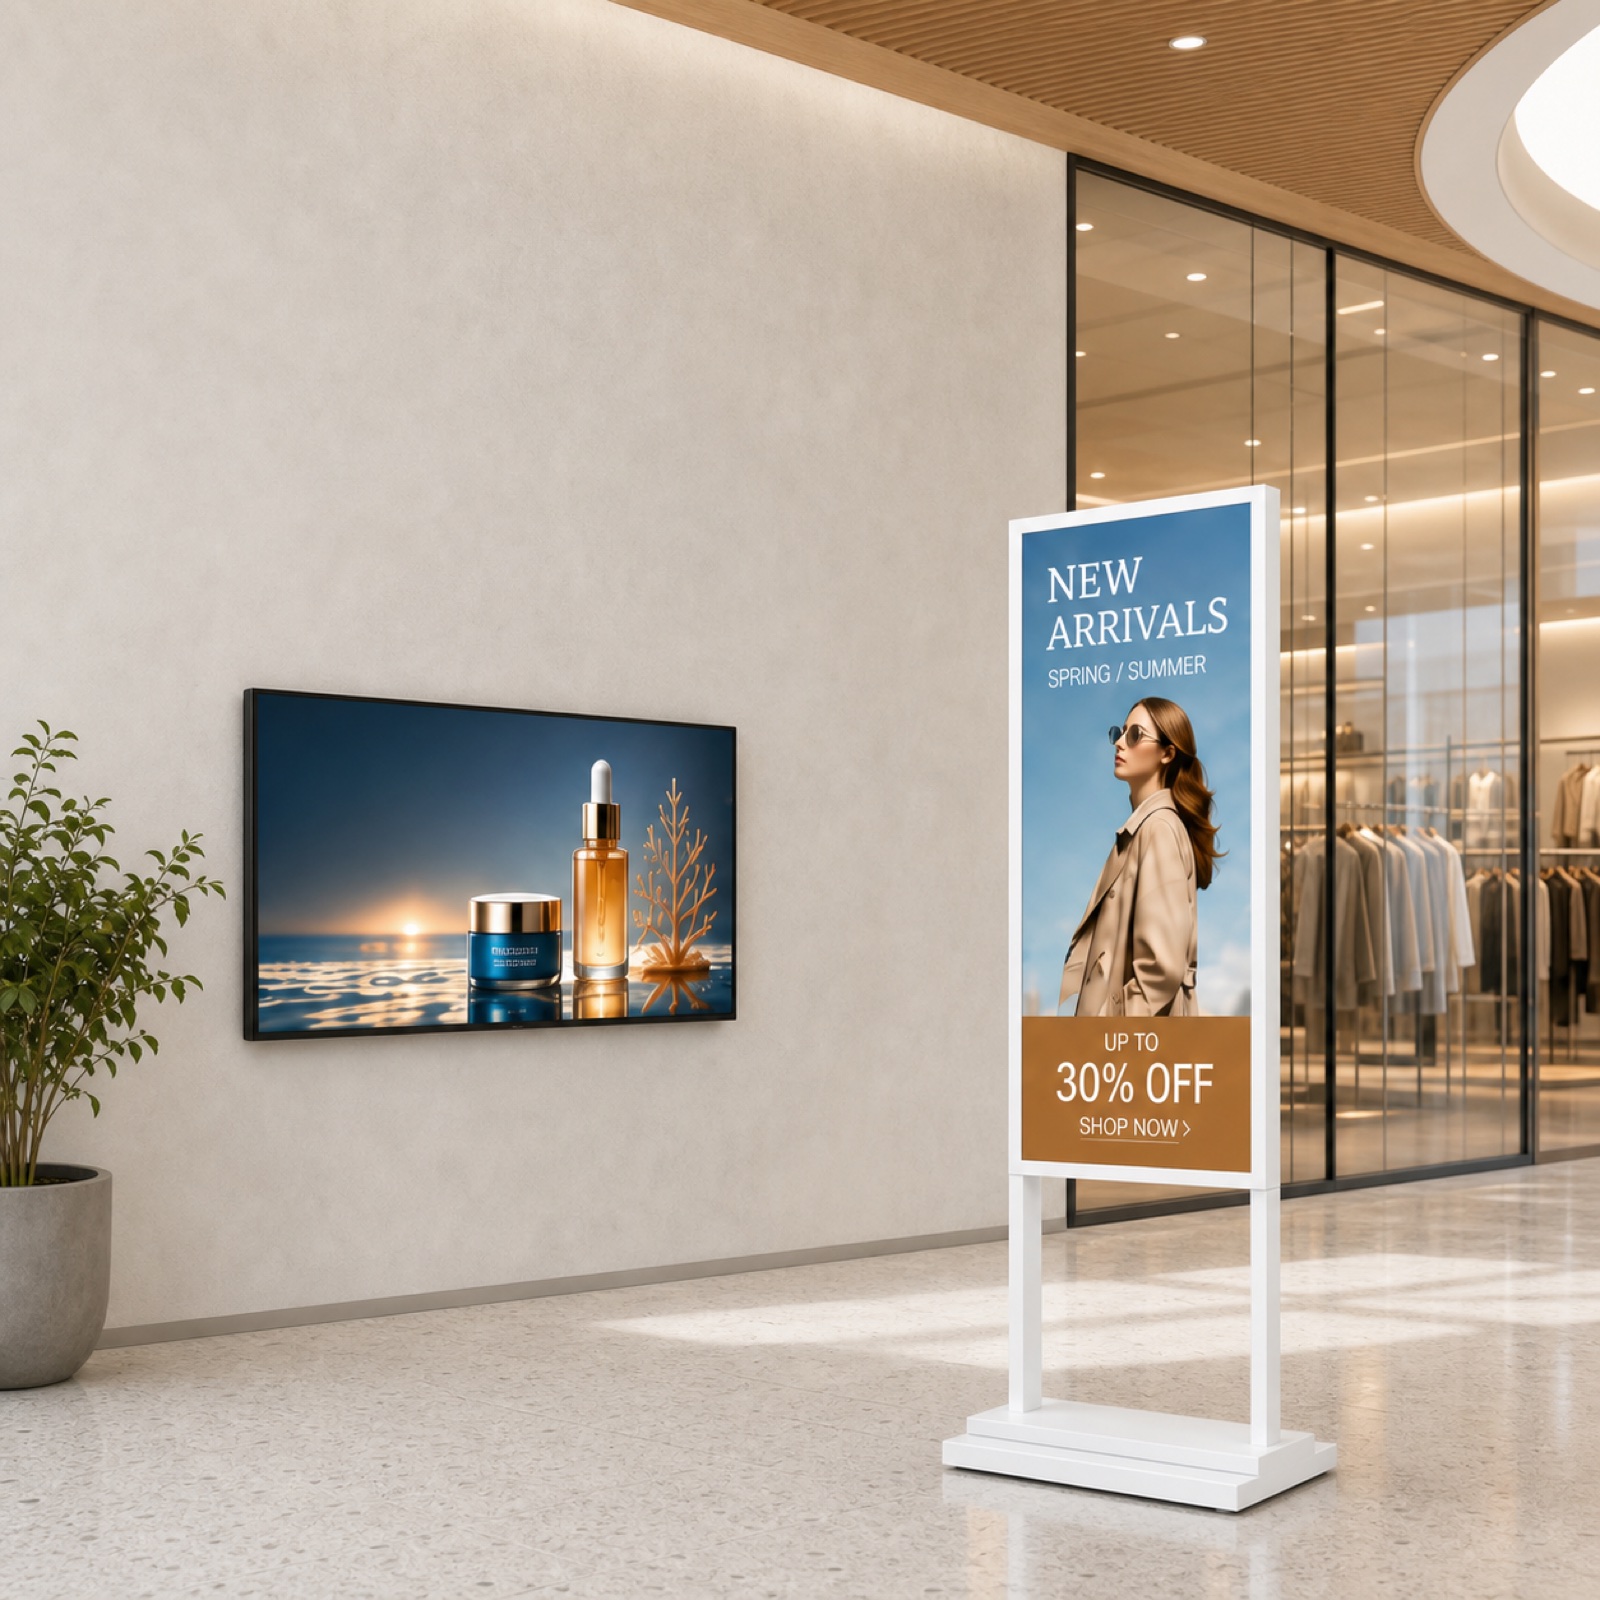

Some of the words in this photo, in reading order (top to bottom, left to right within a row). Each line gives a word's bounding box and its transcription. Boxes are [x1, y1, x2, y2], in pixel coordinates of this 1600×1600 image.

[1047, 556, 1143, 603] NEW
[1046, 596, 1229, 651] ARRIVALS
[1048, 664, 1110, 689] SPRING
[1128, 655, 1207, 681] SUMMER
[1104, 1032, 1129, 1051] UP
[1133, 1032, 1159, 1051] TO
[1056, 1061, 1134, 1103] 30%
[1146, 1062, 1214, 1104] OFF
[1079, 1116, 1129, 1136] SHOP
[1133, 1117, 1179, 1137] NOW
